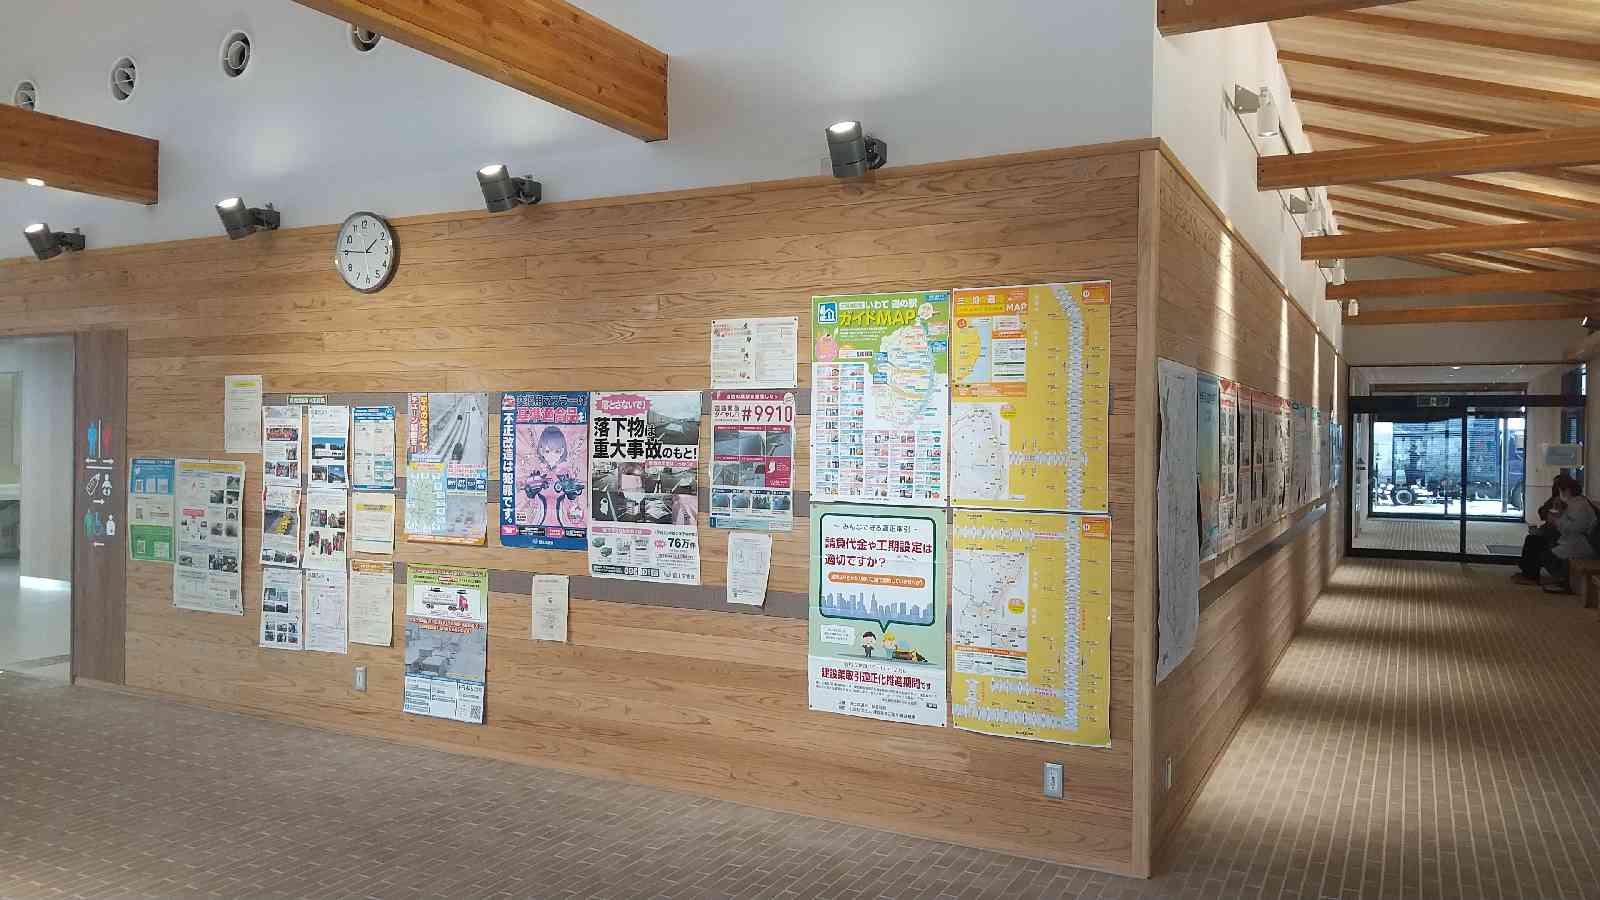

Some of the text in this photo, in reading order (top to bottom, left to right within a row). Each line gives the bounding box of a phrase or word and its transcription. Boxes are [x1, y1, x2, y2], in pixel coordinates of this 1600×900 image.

[353, 224, 358, 232] 11
[361, 220, 368, 229] 12
[380, 232, 385, 241] 2
[384, 246, 389, 255] 3
[347, 263, 353, 272] 8
[382, 260, 387, 268] 4
[356, 272, 361, 280] 7
[375, 269, 381, 279] 5
[1006, 302, 1028, 312] MAP
[742, 405, 793, 423] #9910
[593, 416, 656, 438] 落下物は
[592, 436, 697, 460] 重大事故のもと!
[824, 536, 933, 554] 請負代金や工期設定は
[824, 553, 887, 568] 適切ですか?
